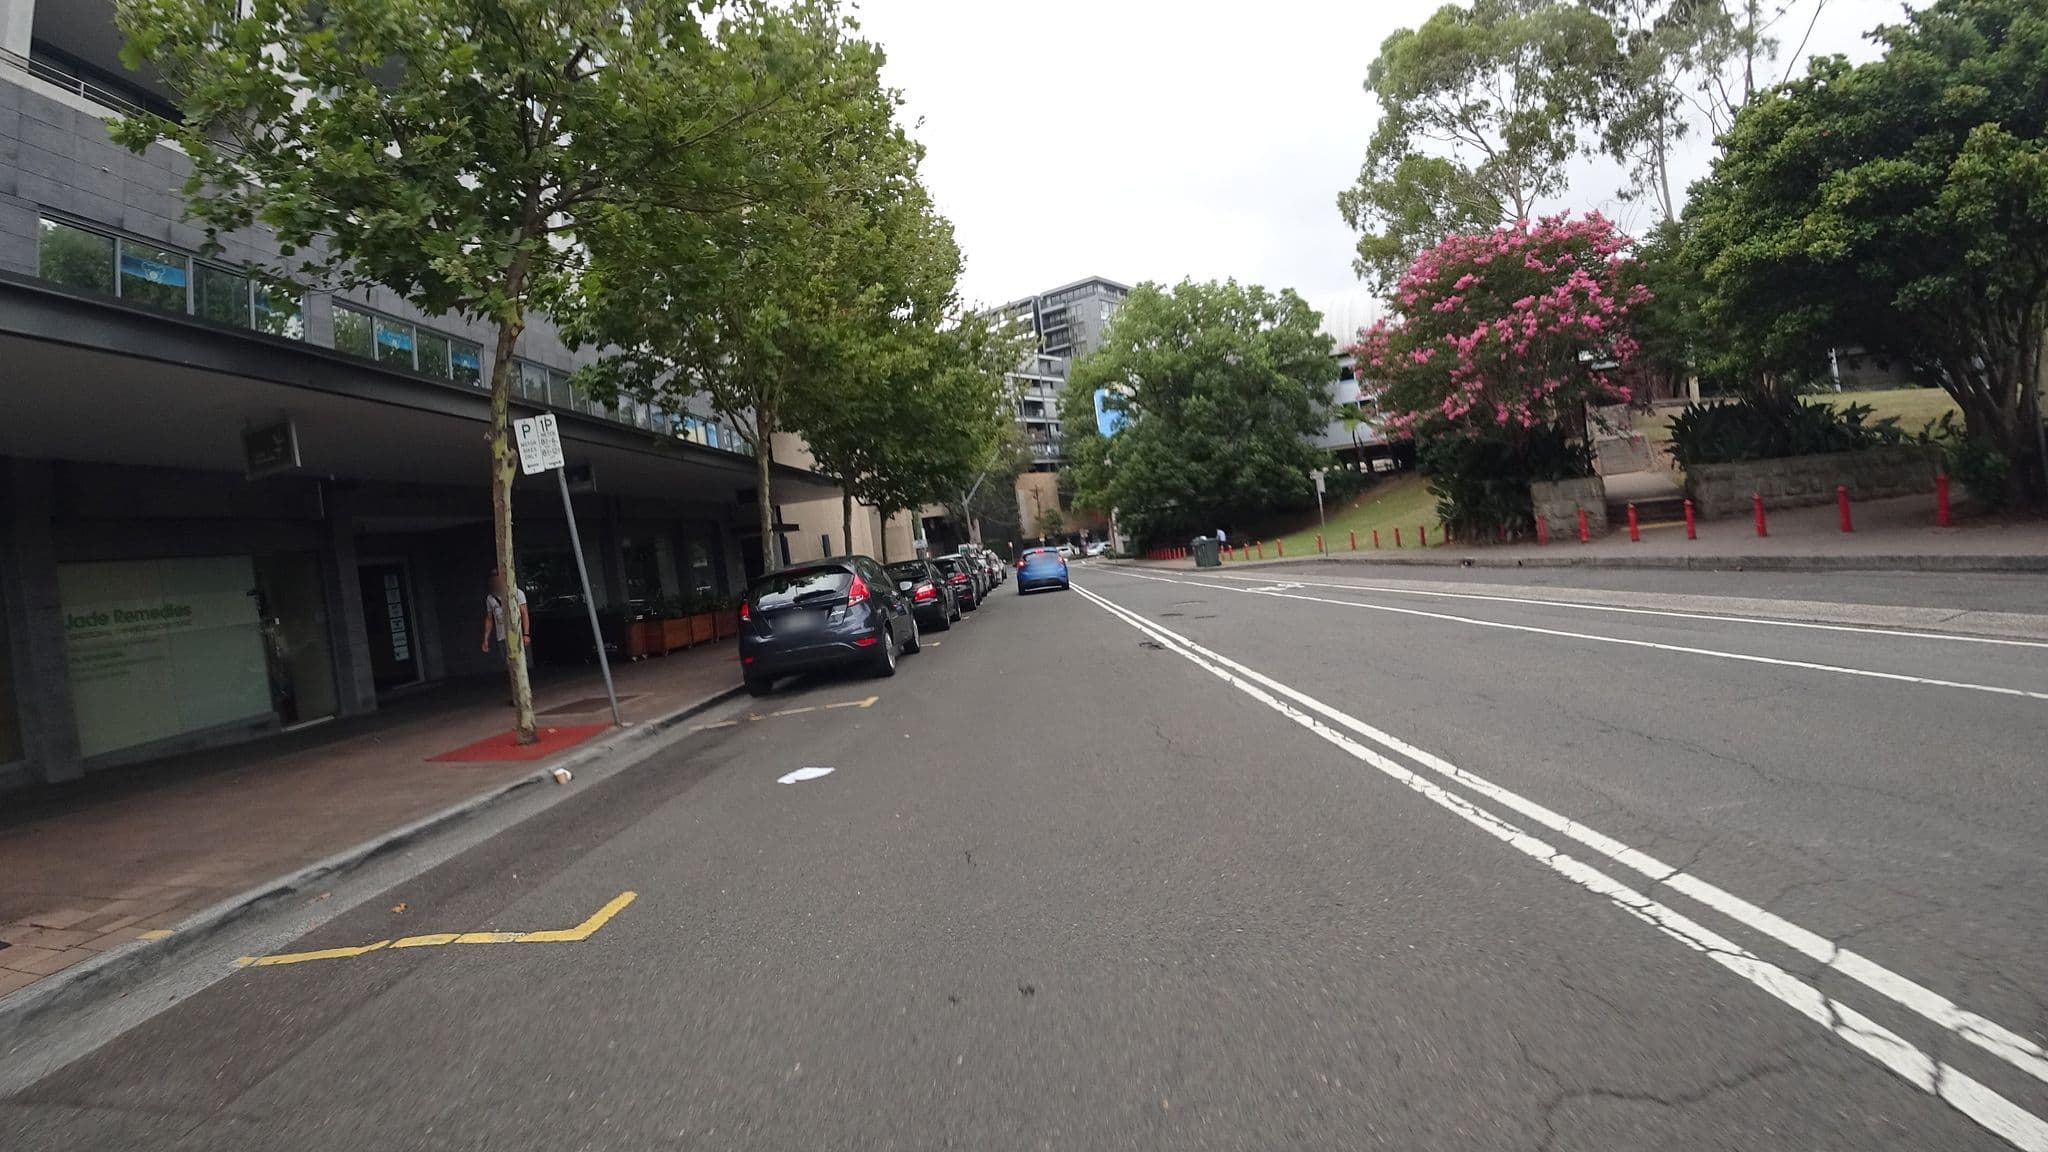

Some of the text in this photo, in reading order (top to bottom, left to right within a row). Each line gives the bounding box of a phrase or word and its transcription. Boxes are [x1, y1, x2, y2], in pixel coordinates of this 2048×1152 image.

[521, 424, 531, 439] P
[65, 612, 109, 630] Jade
[114, 603, 192, 624] Remedies
